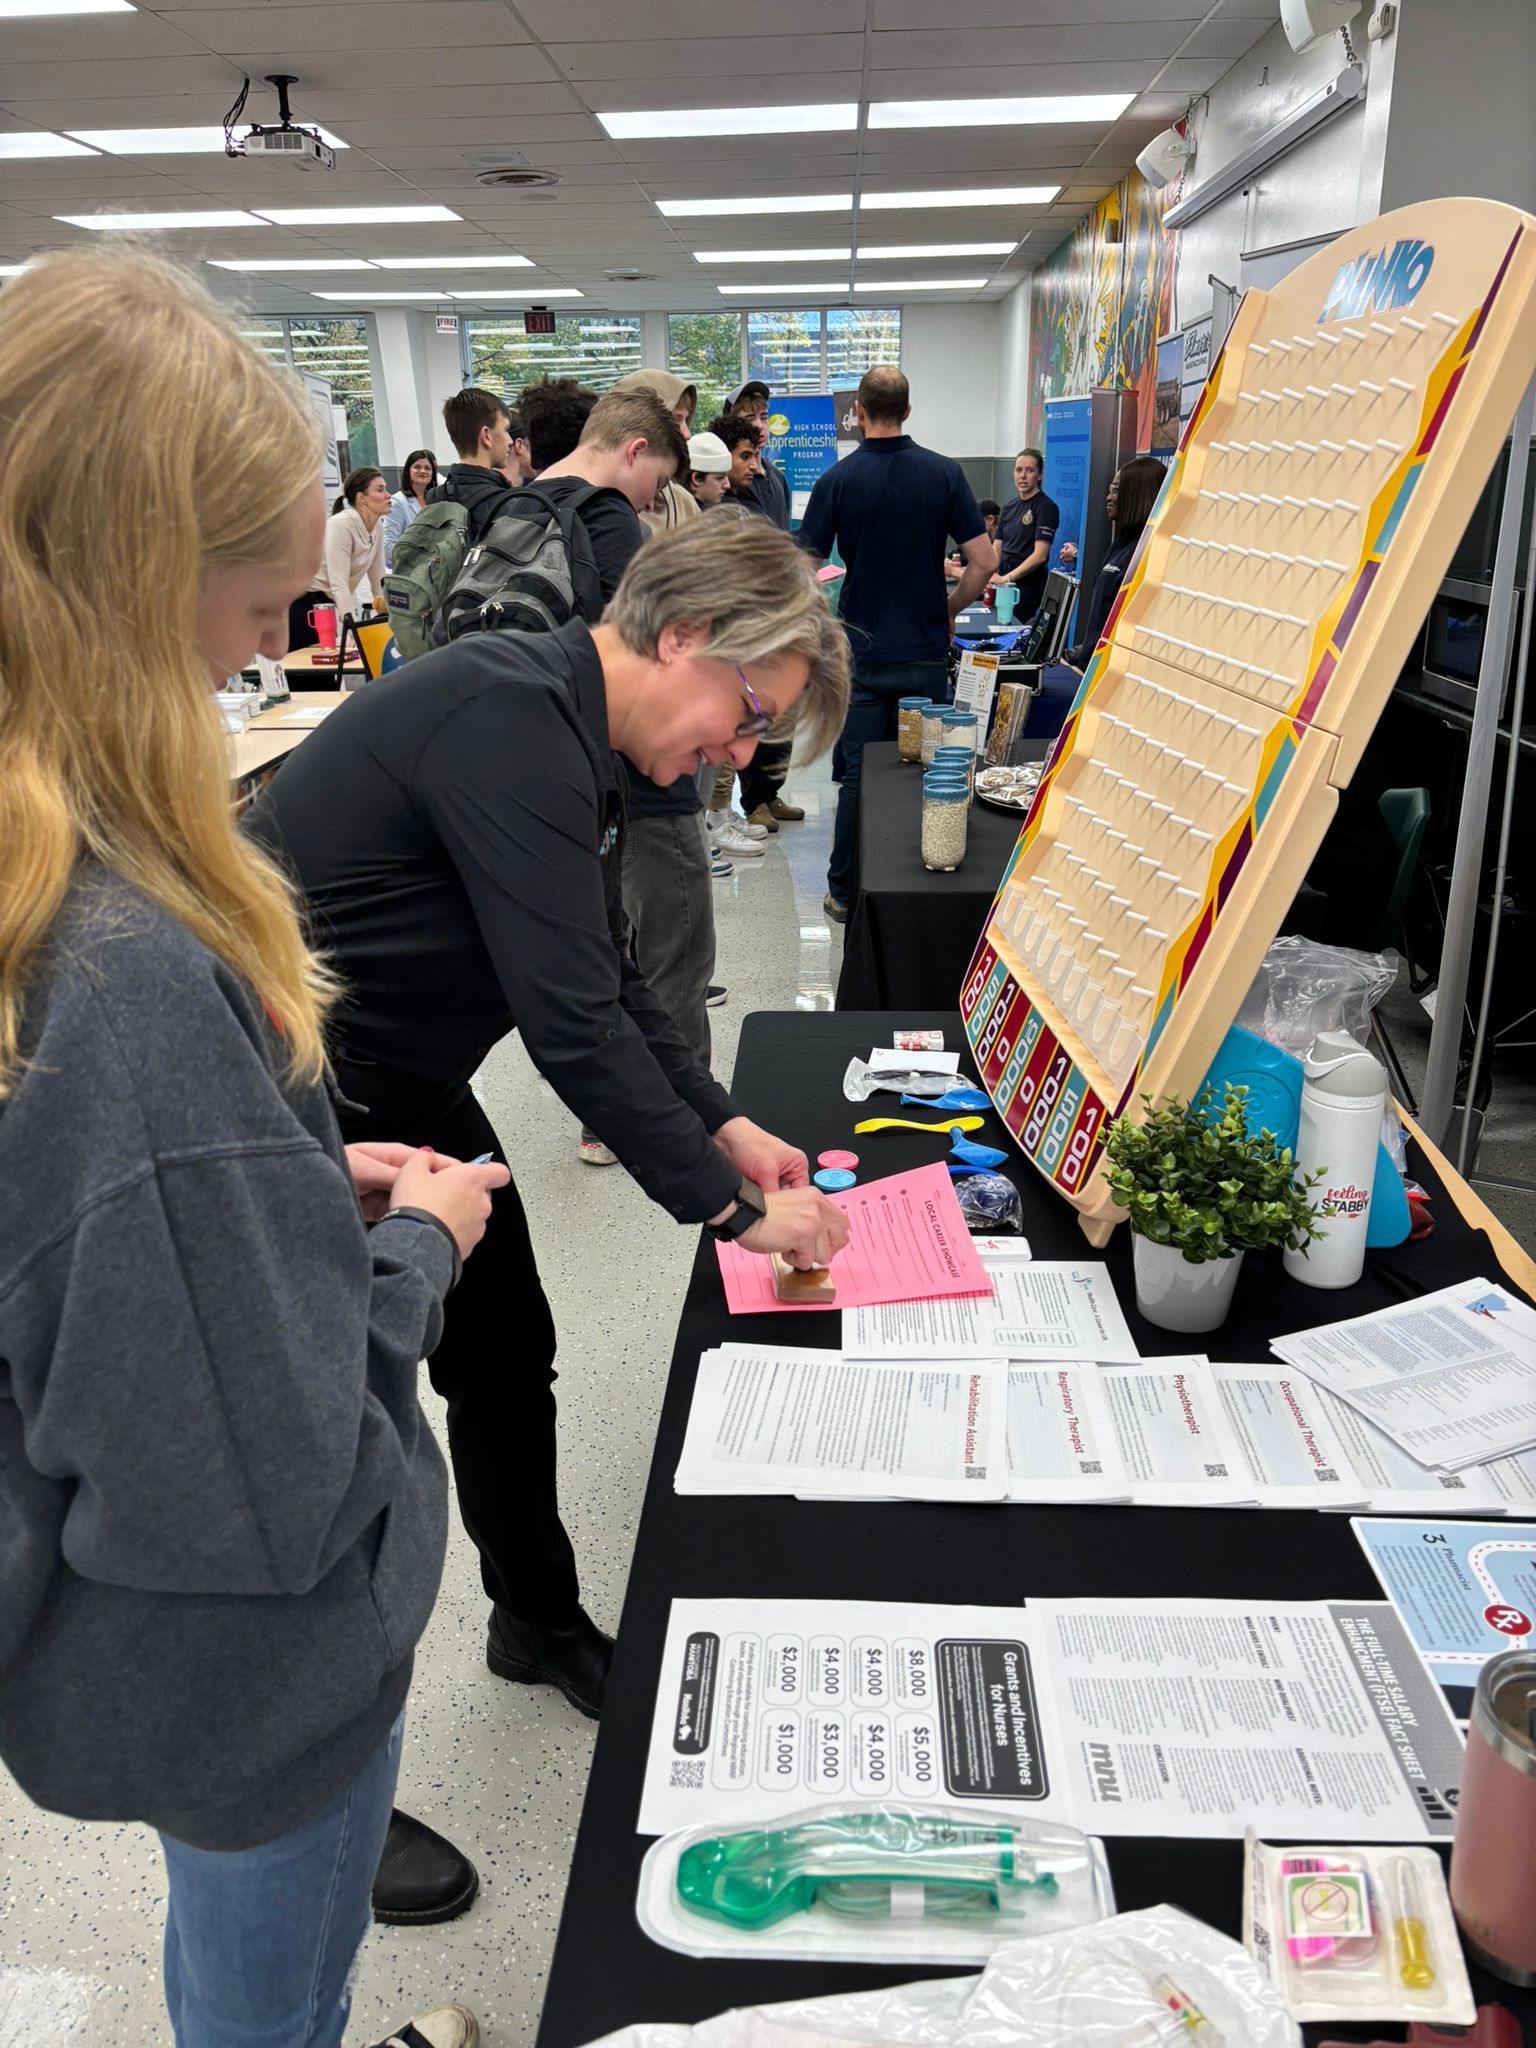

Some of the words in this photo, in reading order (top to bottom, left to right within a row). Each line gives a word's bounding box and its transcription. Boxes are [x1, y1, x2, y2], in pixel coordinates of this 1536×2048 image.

[1316, 239, 1435, 325] PLINKO
[440, 317, 455, 326] FIRE
[528, 314, 552, 332] EXIT
[793, 423, 810, 431] HIGH
[811, 423, 837, 432] SCHOOL
[793, 451, 824, 459] PROGRAM
[965, 956, 993, 1012] 100
[971, 974, 1000, 1037] 500
[978, 983, 1016, 1063] 1000
[996, 1036, 1010, 1063] 0
[1020, 1075, 1035, 1104] 0
[1024, 1057, 1067, 1150] 1000
[1042, 1088, 1079, 1165] 500
[1061, 1107, 1098, 1184] 100
[1321, 1198, 1369, 1213] STABBY
[1327, 1184, 1369, 1200] feeling
[925, 1200, 939, 1223] LOCAL
[934, 1223, 947, 1246] CAREER
[941, 1248, 960, 1278] SHOWCASE
[967, 1374, 981, 1426] Rehabilitation
[1057, 1371, 1076, 1416] Respiratory
[1068, 1416, 1085, 1454] Therapist
[1173, 1374, 1200, 1434] Physiotherapist
[1279, 1380, 1310, 1428] Occupational
[1302, 1430, 1327, 1467] Therapist
[964, 1428, 977, 1464] Assistant
[1422, 1533, 1447, 1545] 3
[1442, 1548, 1472, 1591] Pharmacist
[1356, 1617, 1376, 1635] THE
[686, 1643, 697, 1681] MANITOBA
[780, 1646, 798, 1692] $2,000
[822, 1647, 840, 1694] $4,000
[865, 1648, 883, 1696] $4,000
[908, 1650, 926, 1697] $8,000
[1003, 1652, 1020, 1691] Grants
[1363, 1636, 1398, 1684] FULL-TIME
[680, 1693, 693, 1725] Manitoba
[990, 1684, 1004, 1702] for
[1008, 1692, 1026, 1716] and
[1339, 1618, 1381, 1682] ENHANCMENT
[1369, 1684, 1398, 1716] (FTSE)
[1384, 1718, 1410, 1742] FACT
[1397, 1746, 1427, 1780] SHEET
[1388, 1686, 1419, 1727] SALARY
[992, 1703, 1009, 1746] Nurses
[776, 1723, 795, 1775] $1,000
[821, 1723, 841, 1778] $3,000
[866, 1724, 885, 1781] $4,000
[912, 1726, 931, 1782] $5,000
[1012, 1717, 1032, 1785] Incentives
[1089, 1742, 1122, 1802] mnu
[1153, 1744, 1170, 1784] CONCLUSION:
[1296, 1748, 1315, 1782] ADDITIONAL
[1309, 1784, 1323, 1806] NOTES:
